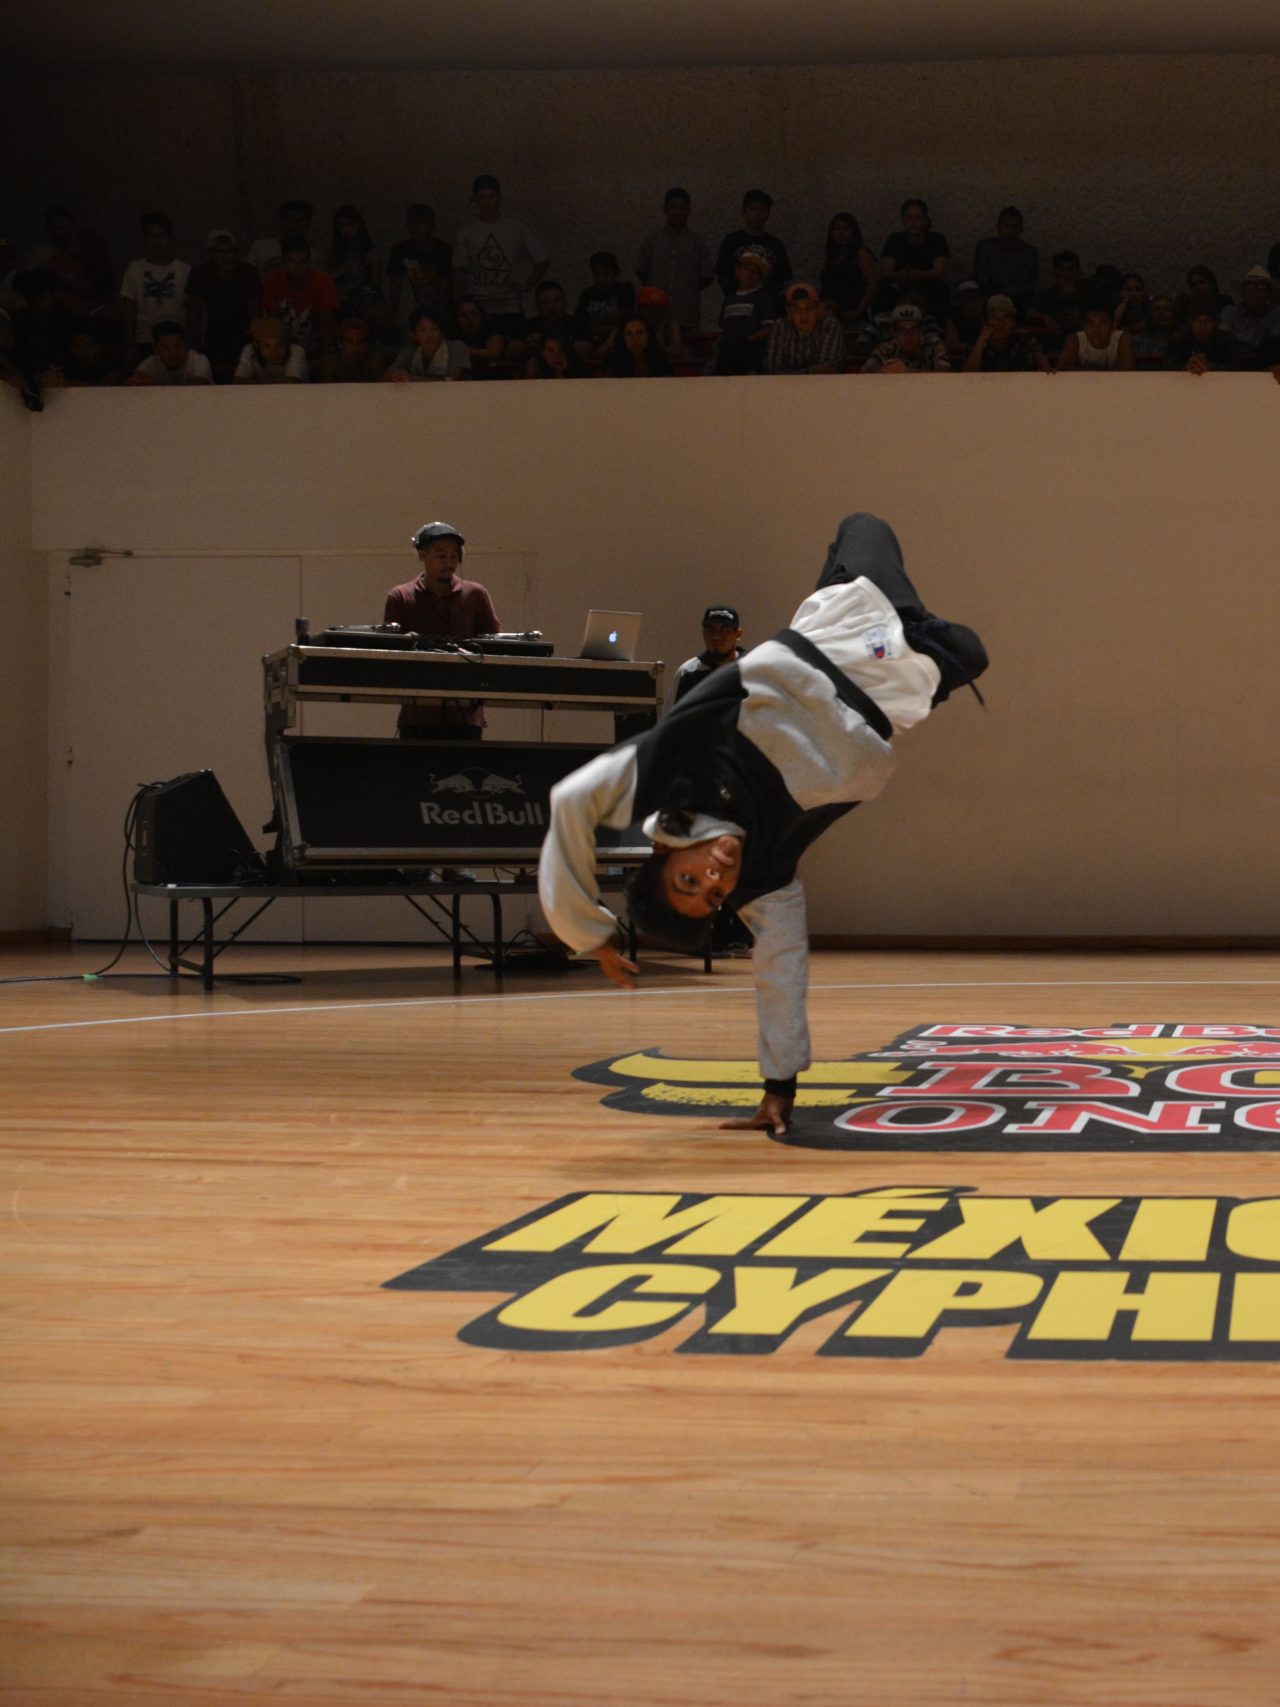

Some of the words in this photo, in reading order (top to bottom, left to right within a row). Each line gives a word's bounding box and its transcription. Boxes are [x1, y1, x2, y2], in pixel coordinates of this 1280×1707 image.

[419, 801, 483, 825] Red
[484, 801, 545, 826] Bull
[918, 1024, 1176, 1038] Red
